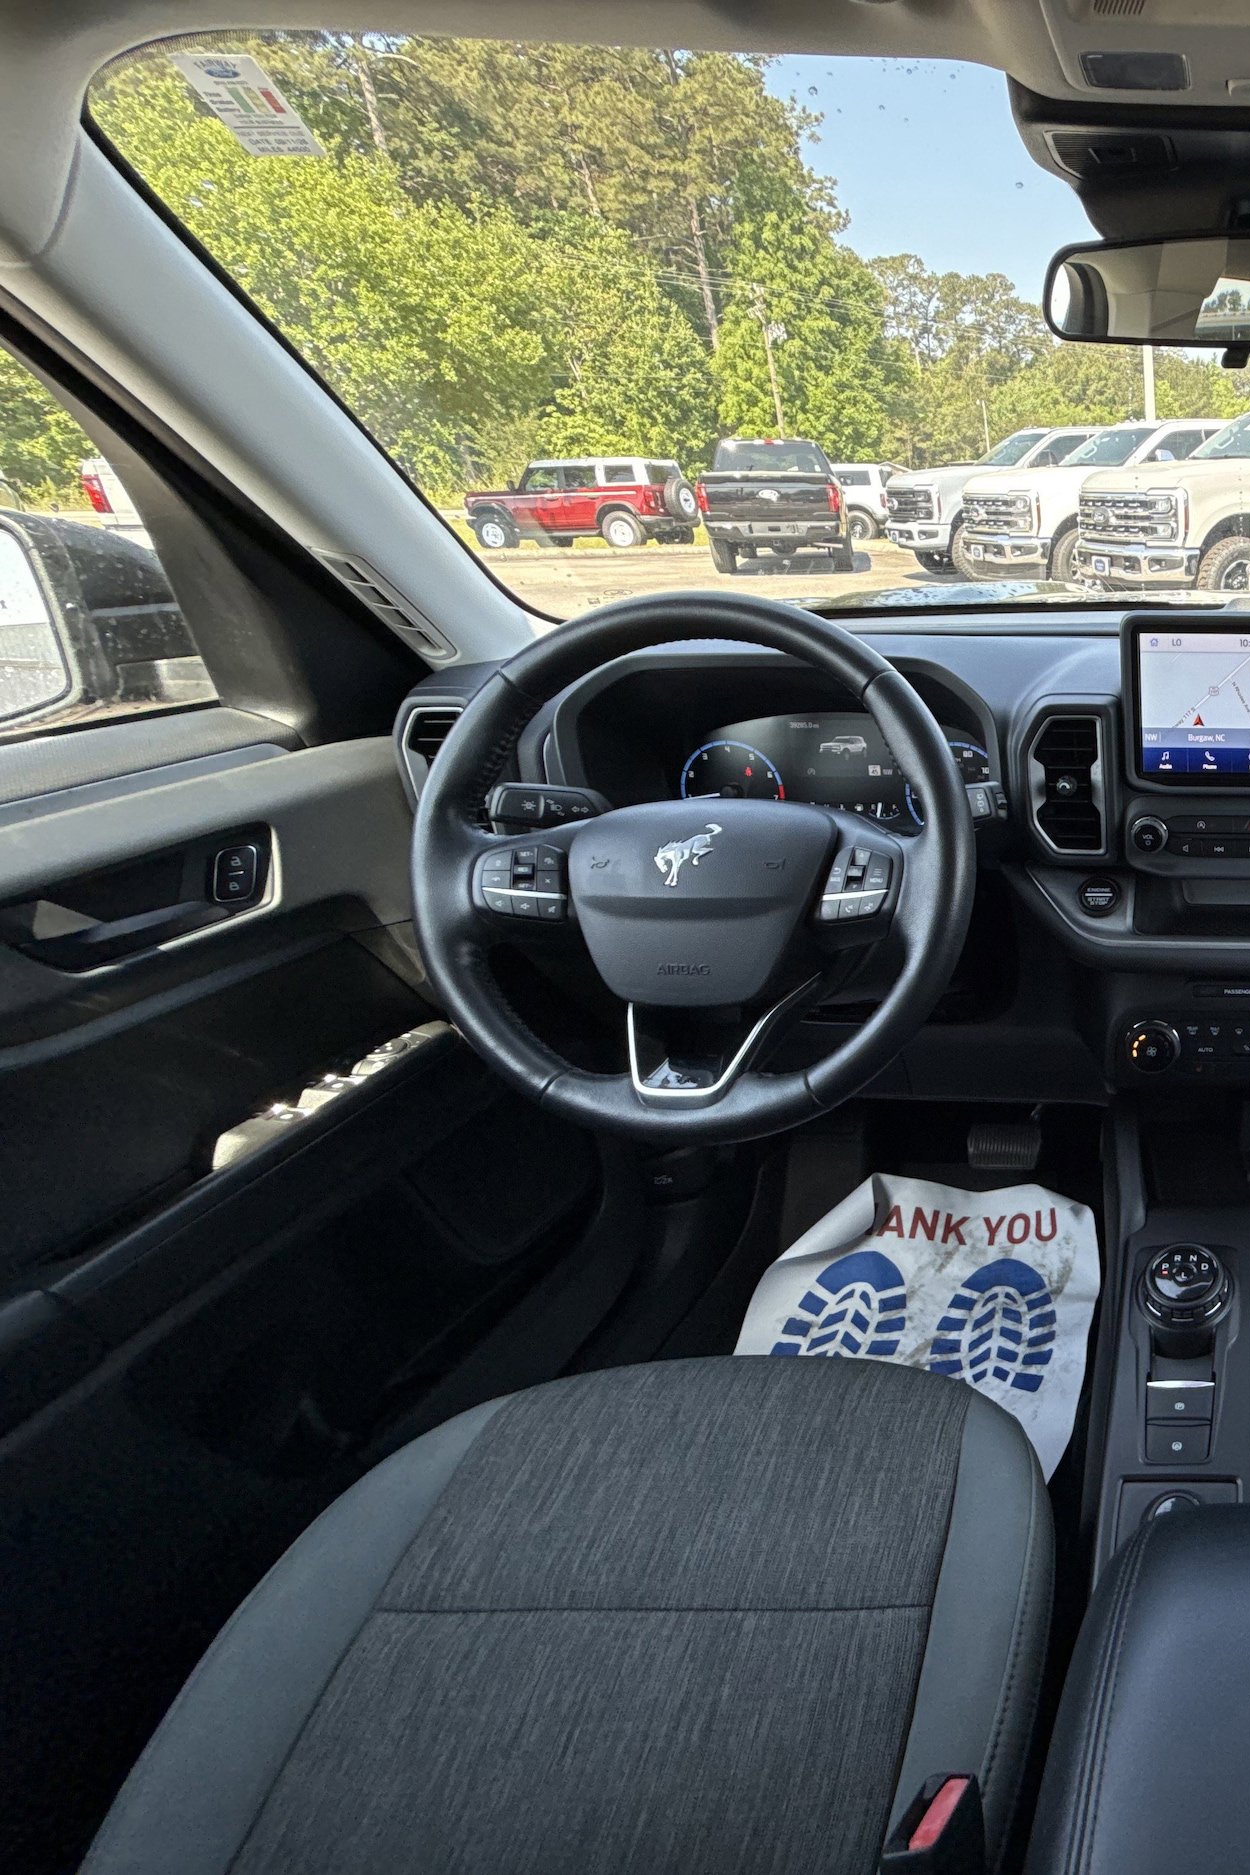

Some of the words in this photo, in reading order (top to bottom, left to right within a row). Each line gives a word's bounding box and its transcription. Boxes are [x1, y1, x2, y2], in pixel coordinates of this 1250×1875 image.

[1145, 734, 1157, 742] NW
[1188, 734, 1214, 743] Burgaw,
[1215, 734, 1225, 742] NC
[656, 963, 711, 976] AIRBAG
[864, 1204, 970, 1246] ANK
[982, 1207, 1059, 1246] YOU
[1174, 1254, 1182, 1262] R
[1189, 1254, 1198, 1262] N
[1161, 1262, 1170, 1271] P
[1201, 1263, 1209, 1271] D
